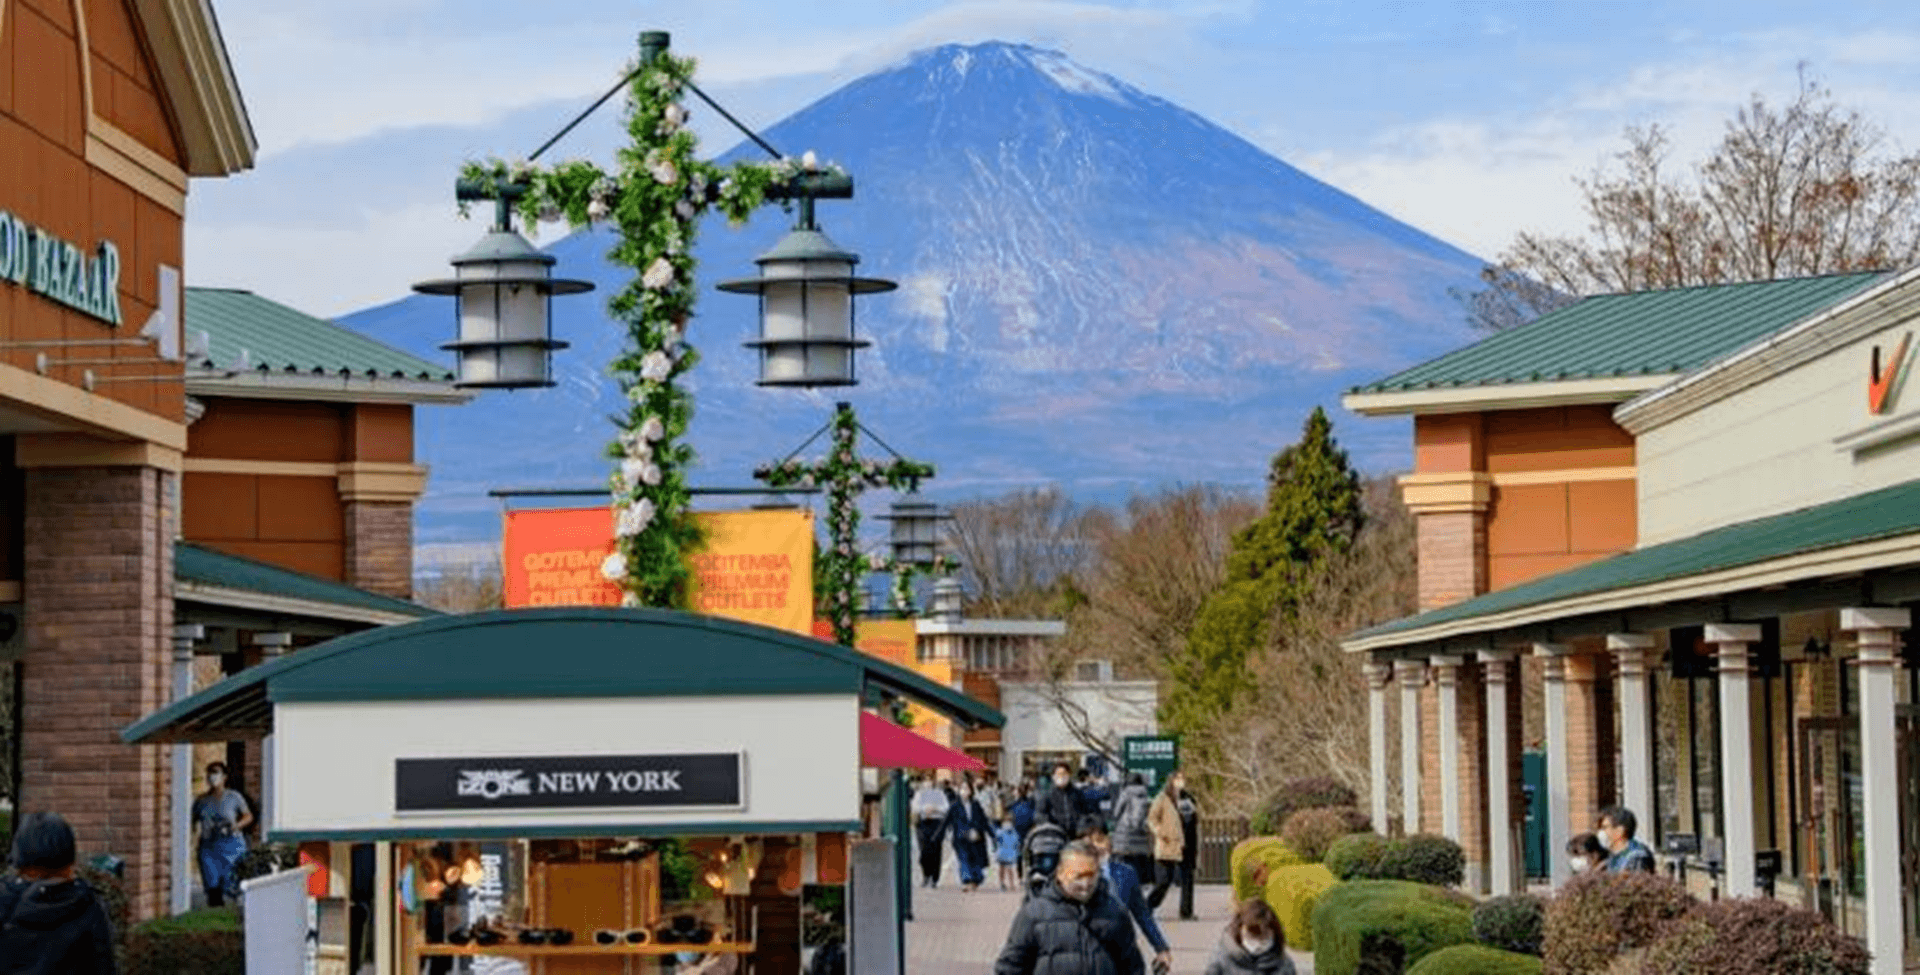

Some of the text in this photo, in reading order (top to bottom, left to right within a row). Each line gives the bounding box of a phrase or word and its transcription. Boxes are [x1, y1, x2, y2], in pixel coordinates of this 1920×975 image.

[35, 227, 123, 325] BAZAAR
[538, 771, 600, 793] NEW
[605, 769, 682, 792] YORK
